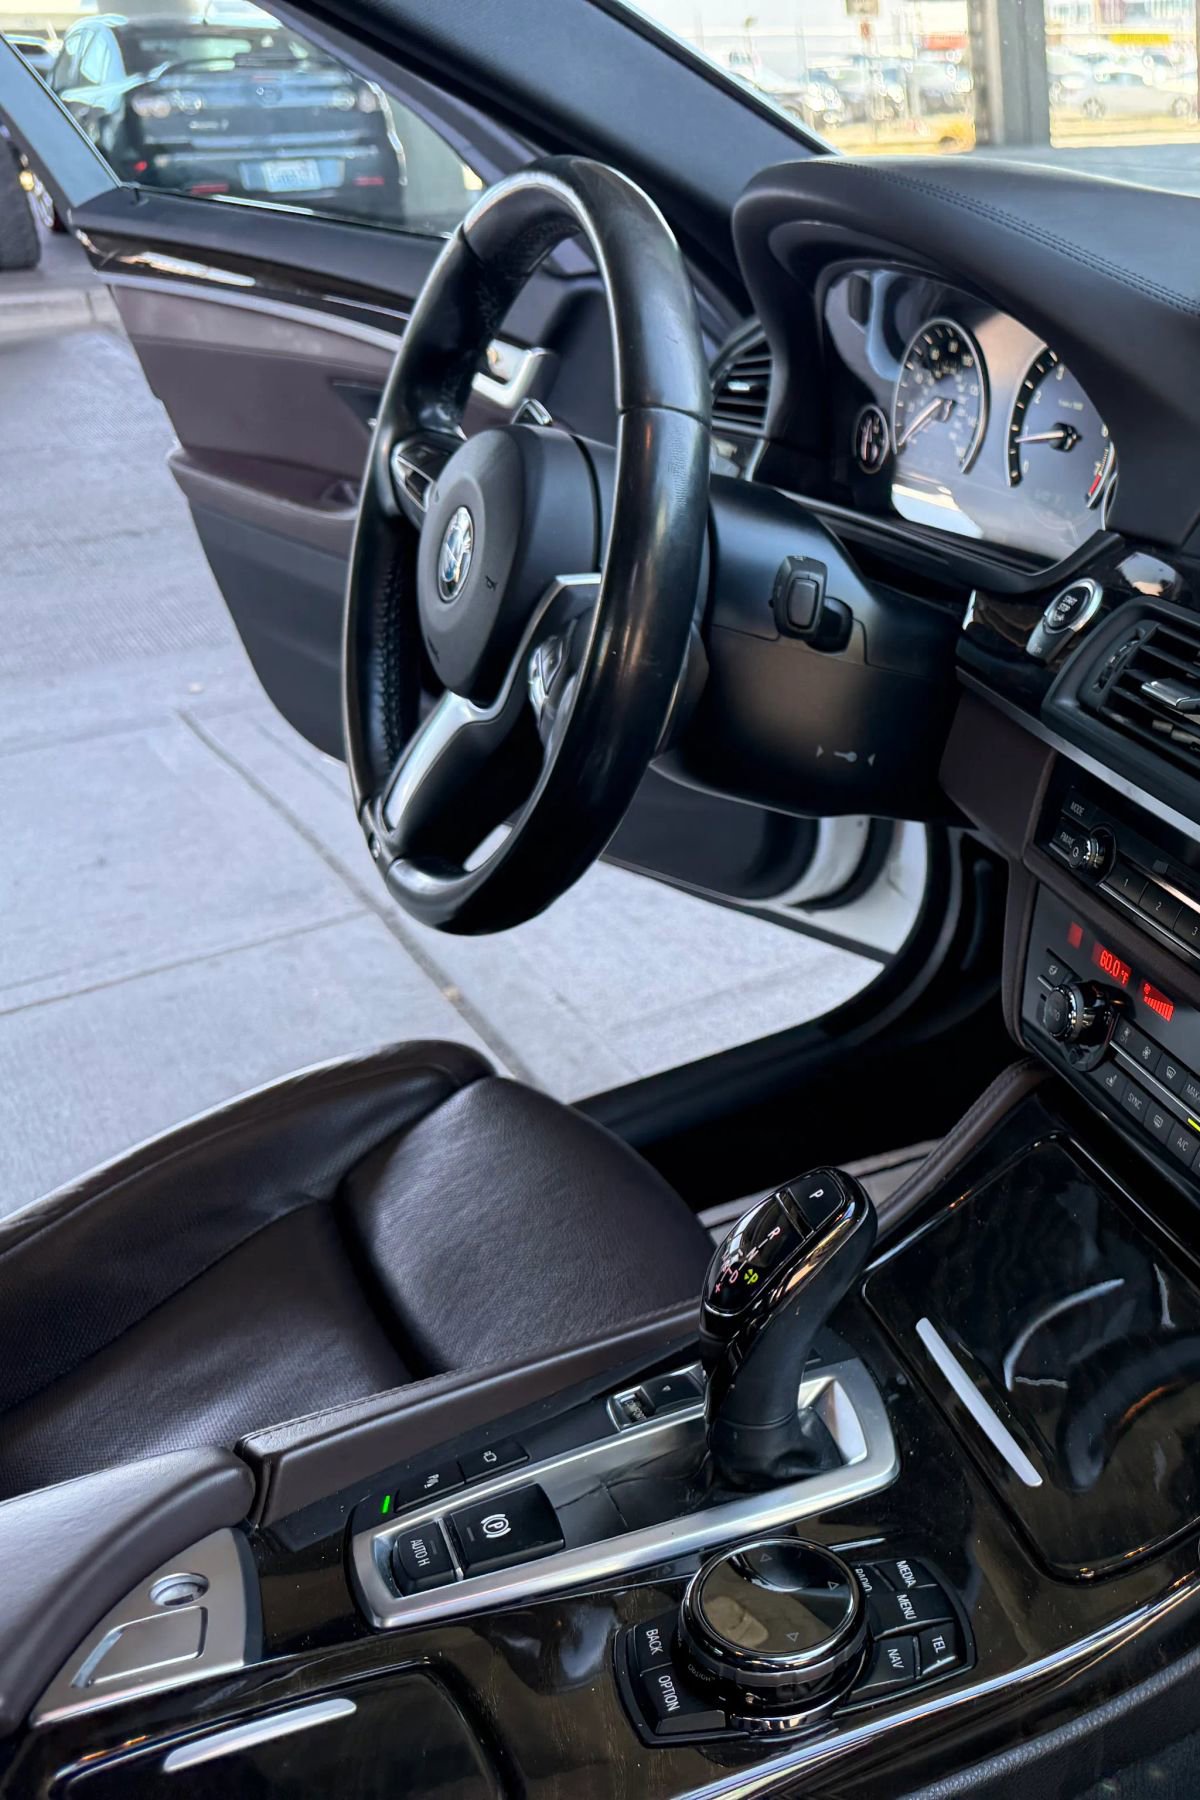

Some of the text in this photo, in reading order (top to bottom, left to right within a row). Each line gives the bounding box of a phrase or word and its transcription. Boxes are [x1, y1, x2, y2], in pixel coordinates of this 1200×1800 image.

[1123, 878, 1129, 887] 1
[1155, 901, 1163, 911] 2
[1191, 927, 1199, 936] 3
[1100, 949, 1121, 977] 60.0
[1127, 1092, 1143, 1111] SYNC
[1176, 1137, 1189, 1152] A/C
[808, 1189, 824, 1199] P
[767, 1226, 781, 1240] R
[746, 1246, 759, 1261] N
[729, 1269, 739, 1284] D
[410, 1539, 431, 1567] AUTO H
[896, 1560, 917, 1588] MEDIA
[897, 1594, 917, 1620] MENU
[645, 1628, 664, 1656] BACK
[932, 1635, 946, 1654] TEL
[888, 1648, 904, 1668] NAV
[658, 1675, 681, 1712] OPTION
